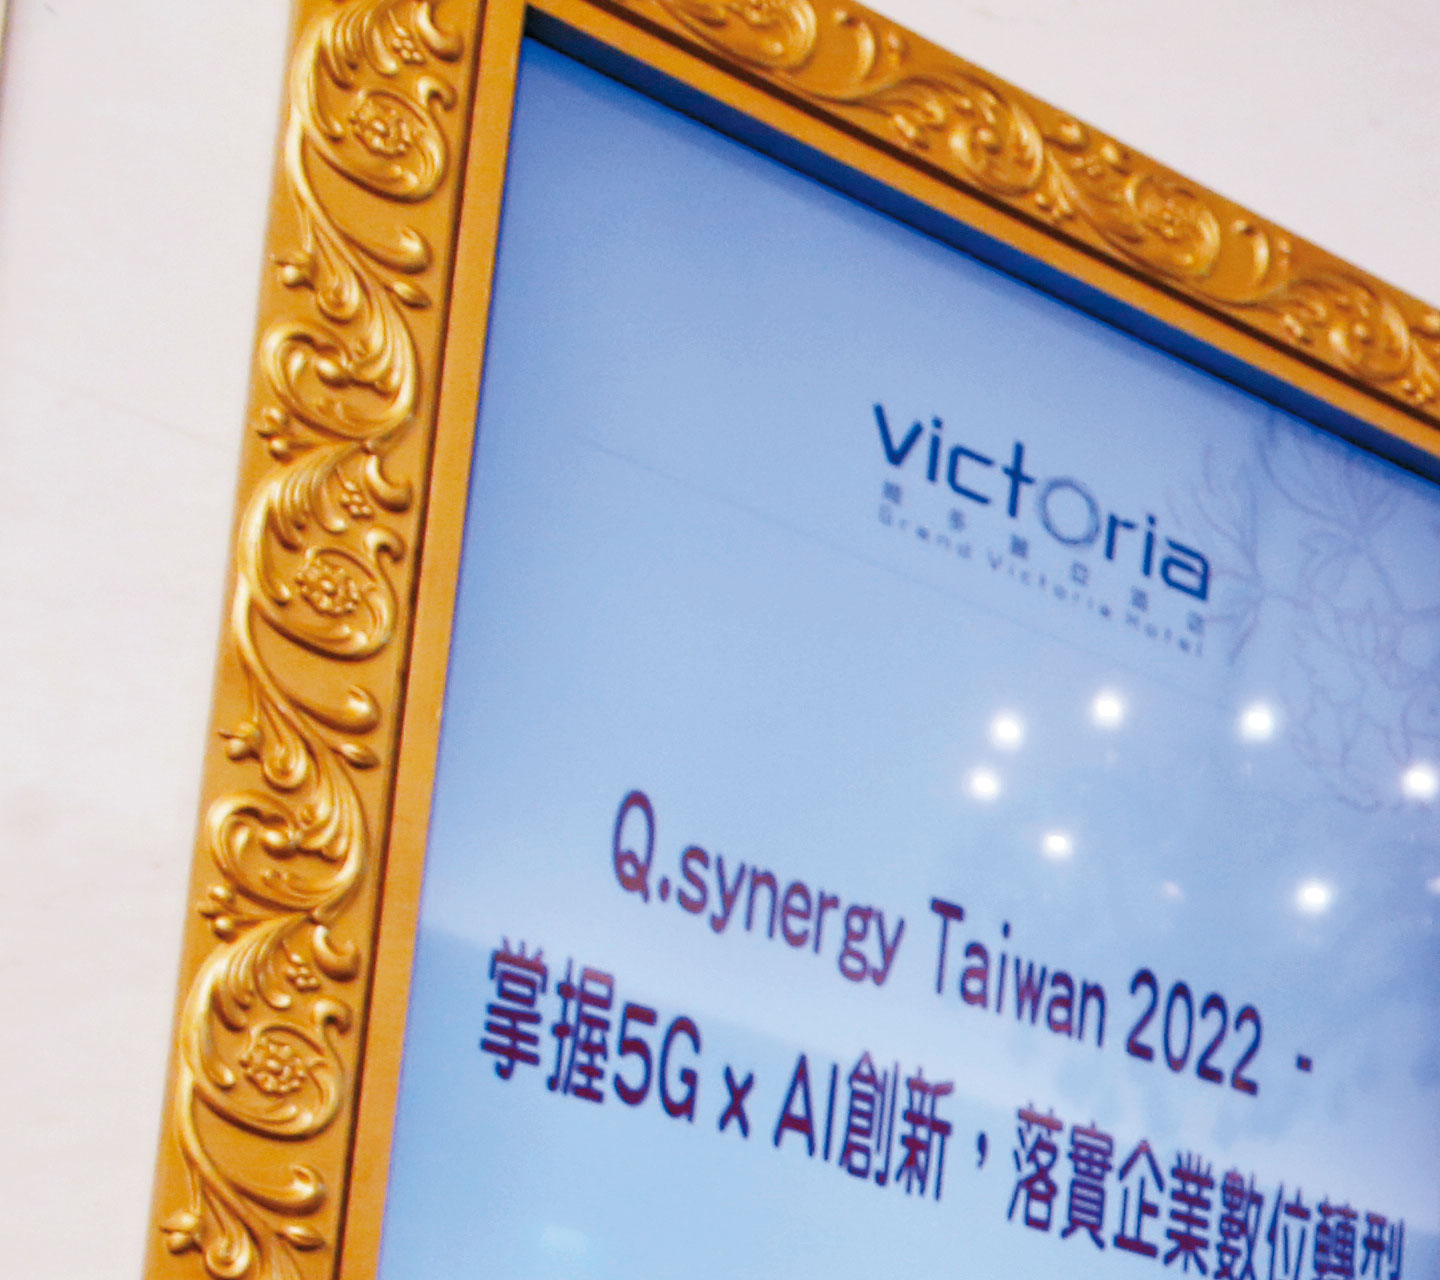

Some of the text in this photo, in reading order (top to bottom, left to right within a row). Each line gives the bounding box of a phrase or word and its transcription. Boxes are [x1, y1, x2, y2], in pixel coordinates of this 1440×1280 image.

[612, 791, 905, 987] Q.synergy
[930, 897, 1106, 1049] Taiwan
[1127, 969, 1263, 1096] 2022
